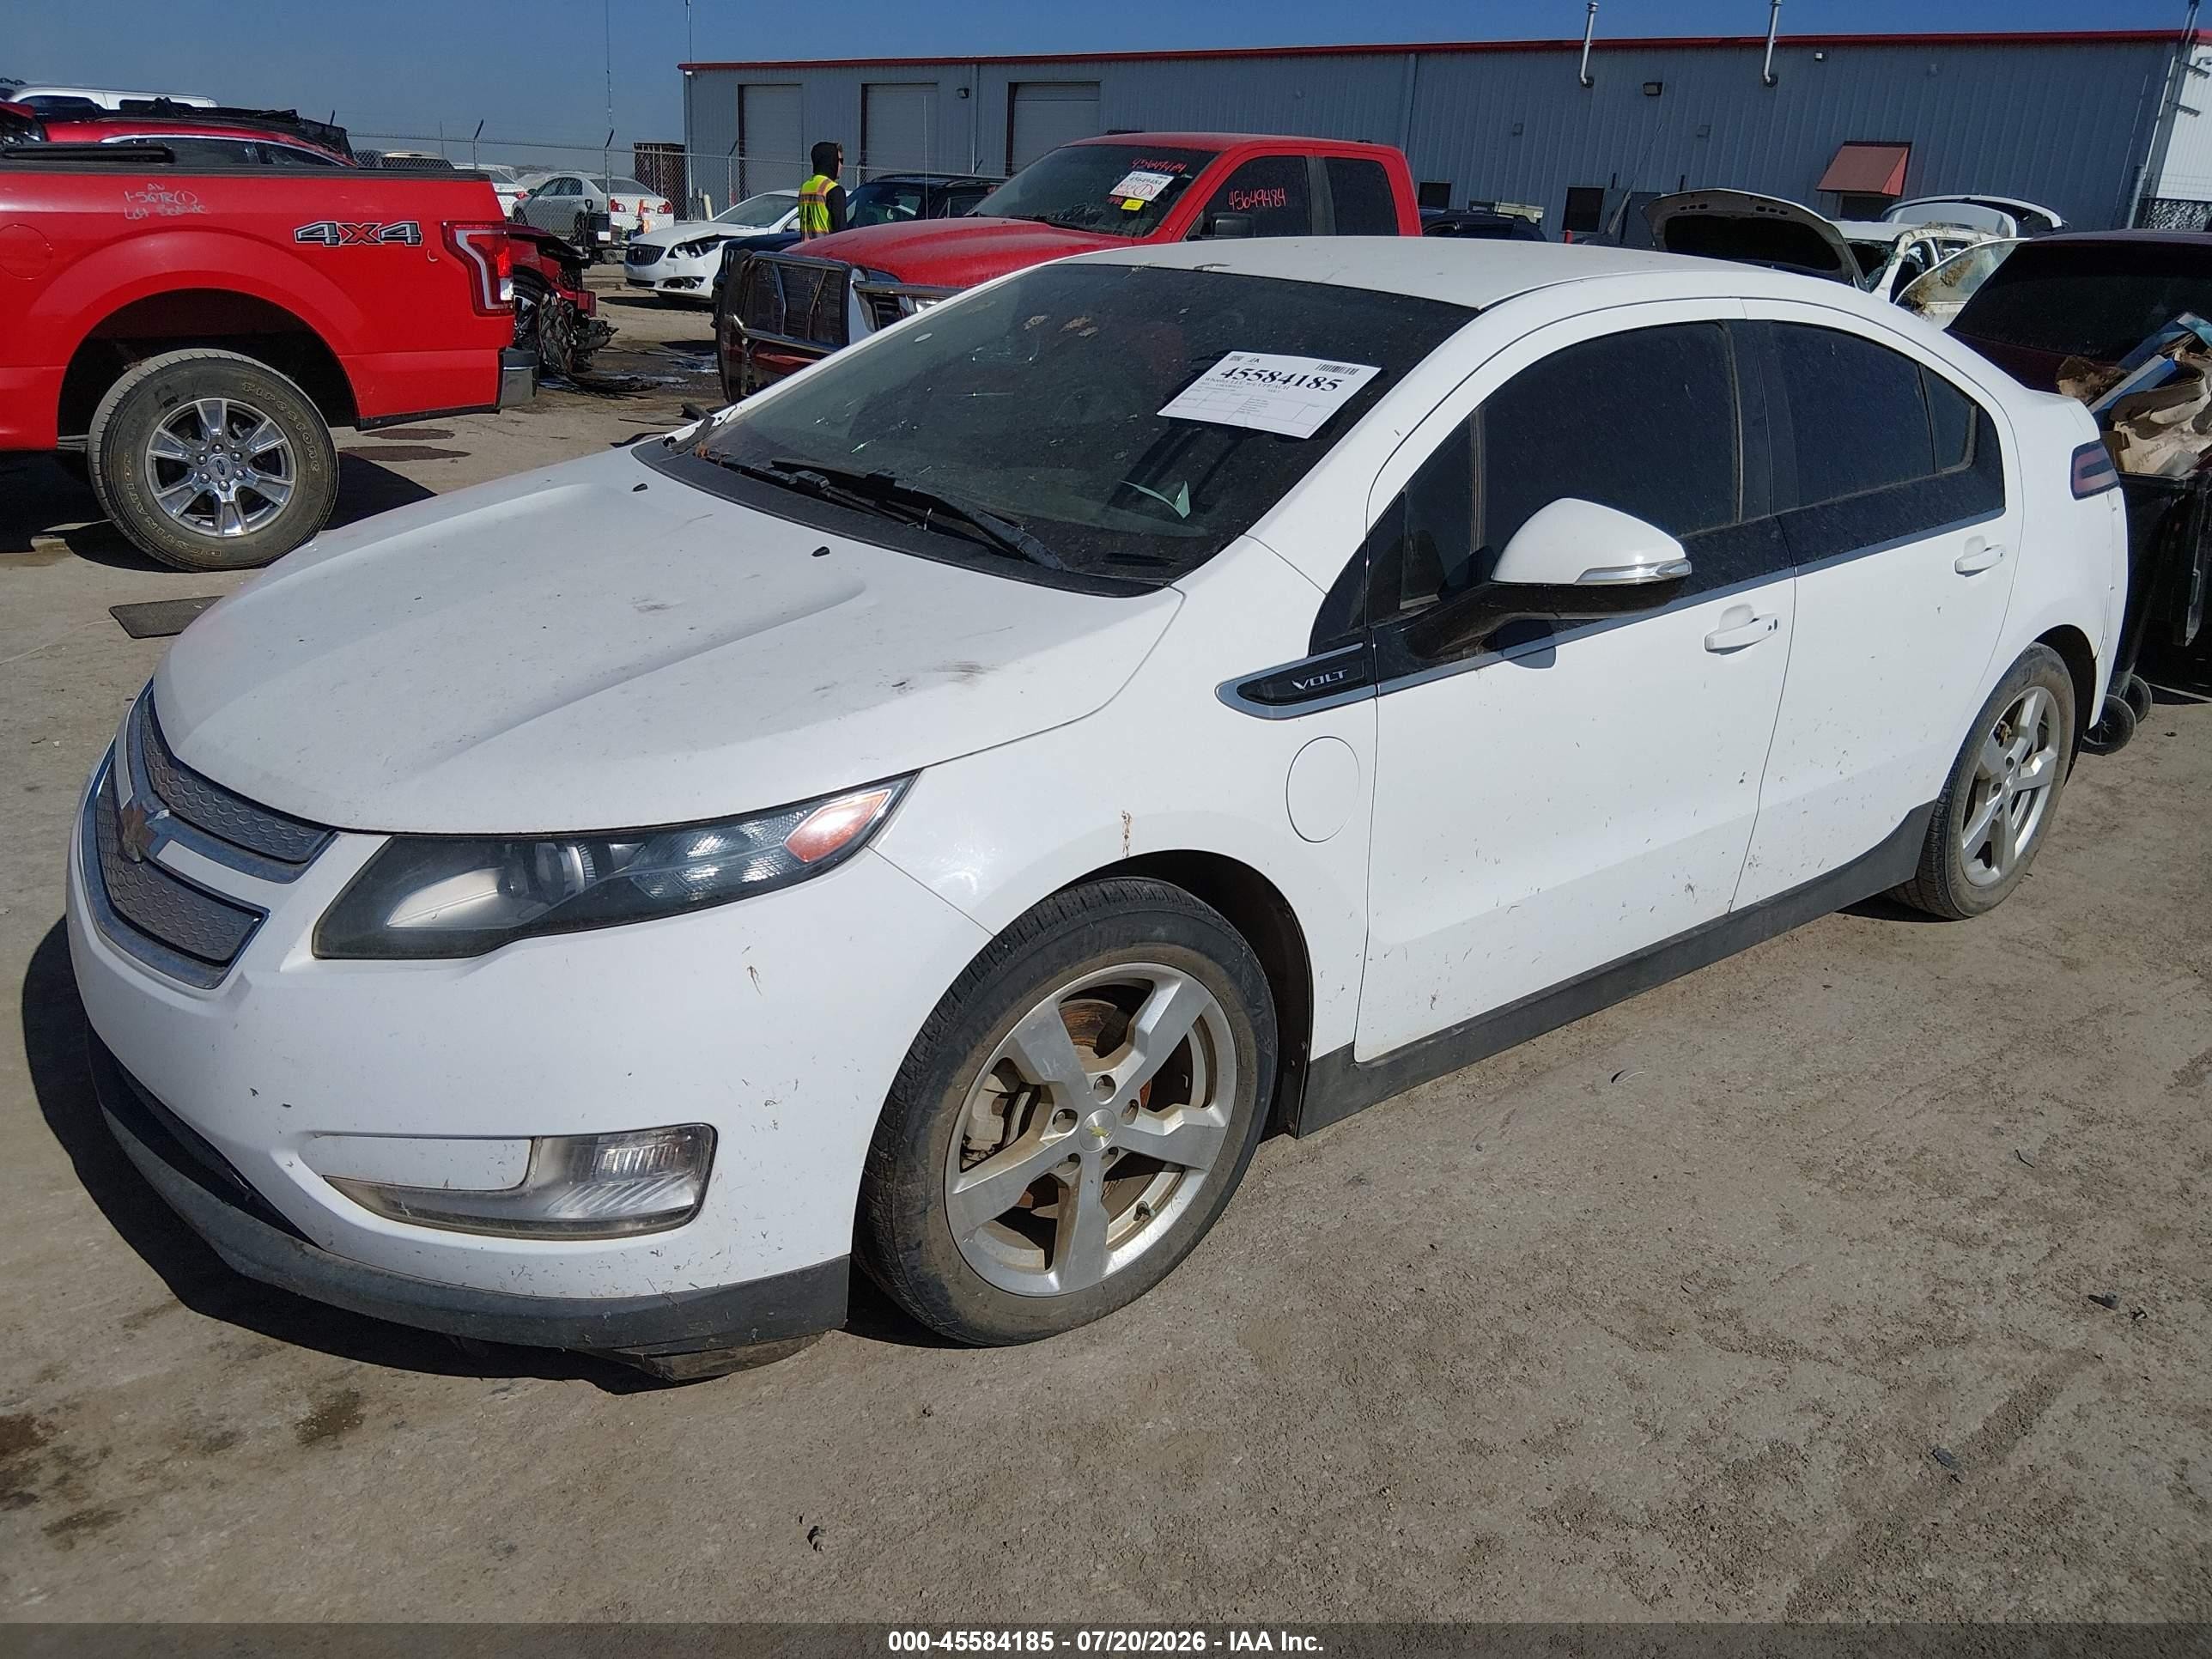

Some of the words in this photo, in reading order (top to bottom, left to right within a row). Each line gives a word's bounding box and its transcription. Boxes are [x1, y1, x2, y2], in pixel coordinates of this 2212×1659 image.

[1228, 187, 1286, 210] 45649484
[1220, 367, 1345, 391] 45584185
[1291, 668, 1348, 691] VOLT
